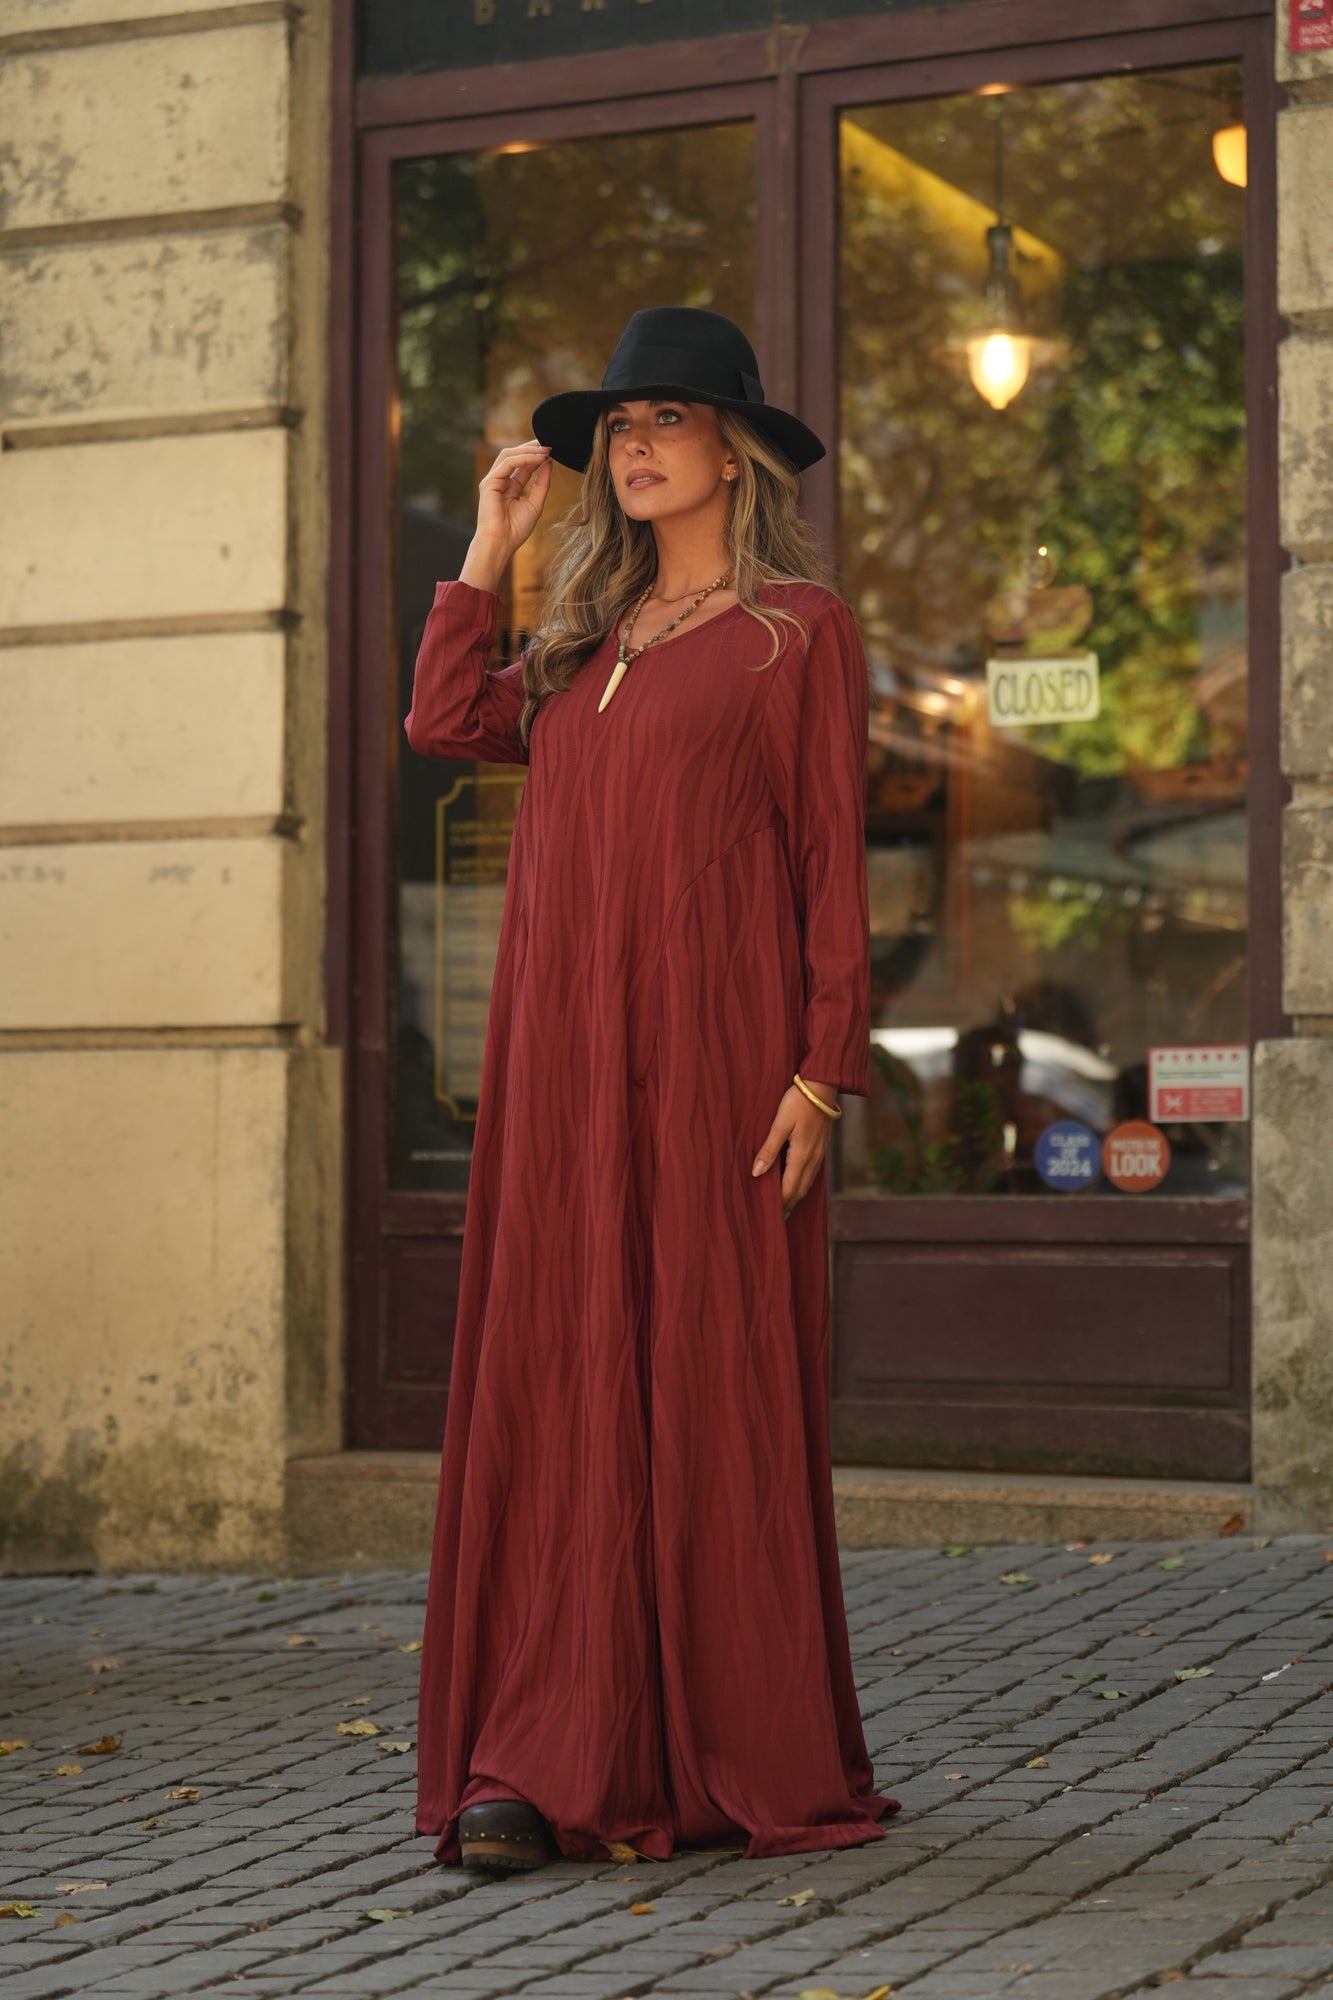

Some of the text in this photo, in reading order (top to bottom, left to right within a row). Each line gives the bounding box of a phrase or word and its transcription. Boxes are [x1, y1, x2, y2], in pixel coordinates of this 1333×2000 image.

[994, 669, 1092, 715] CLOSED
[1048, 1158, 1092, 1176] 2024
[1111, 1154, 1161, 1177] LOOK
